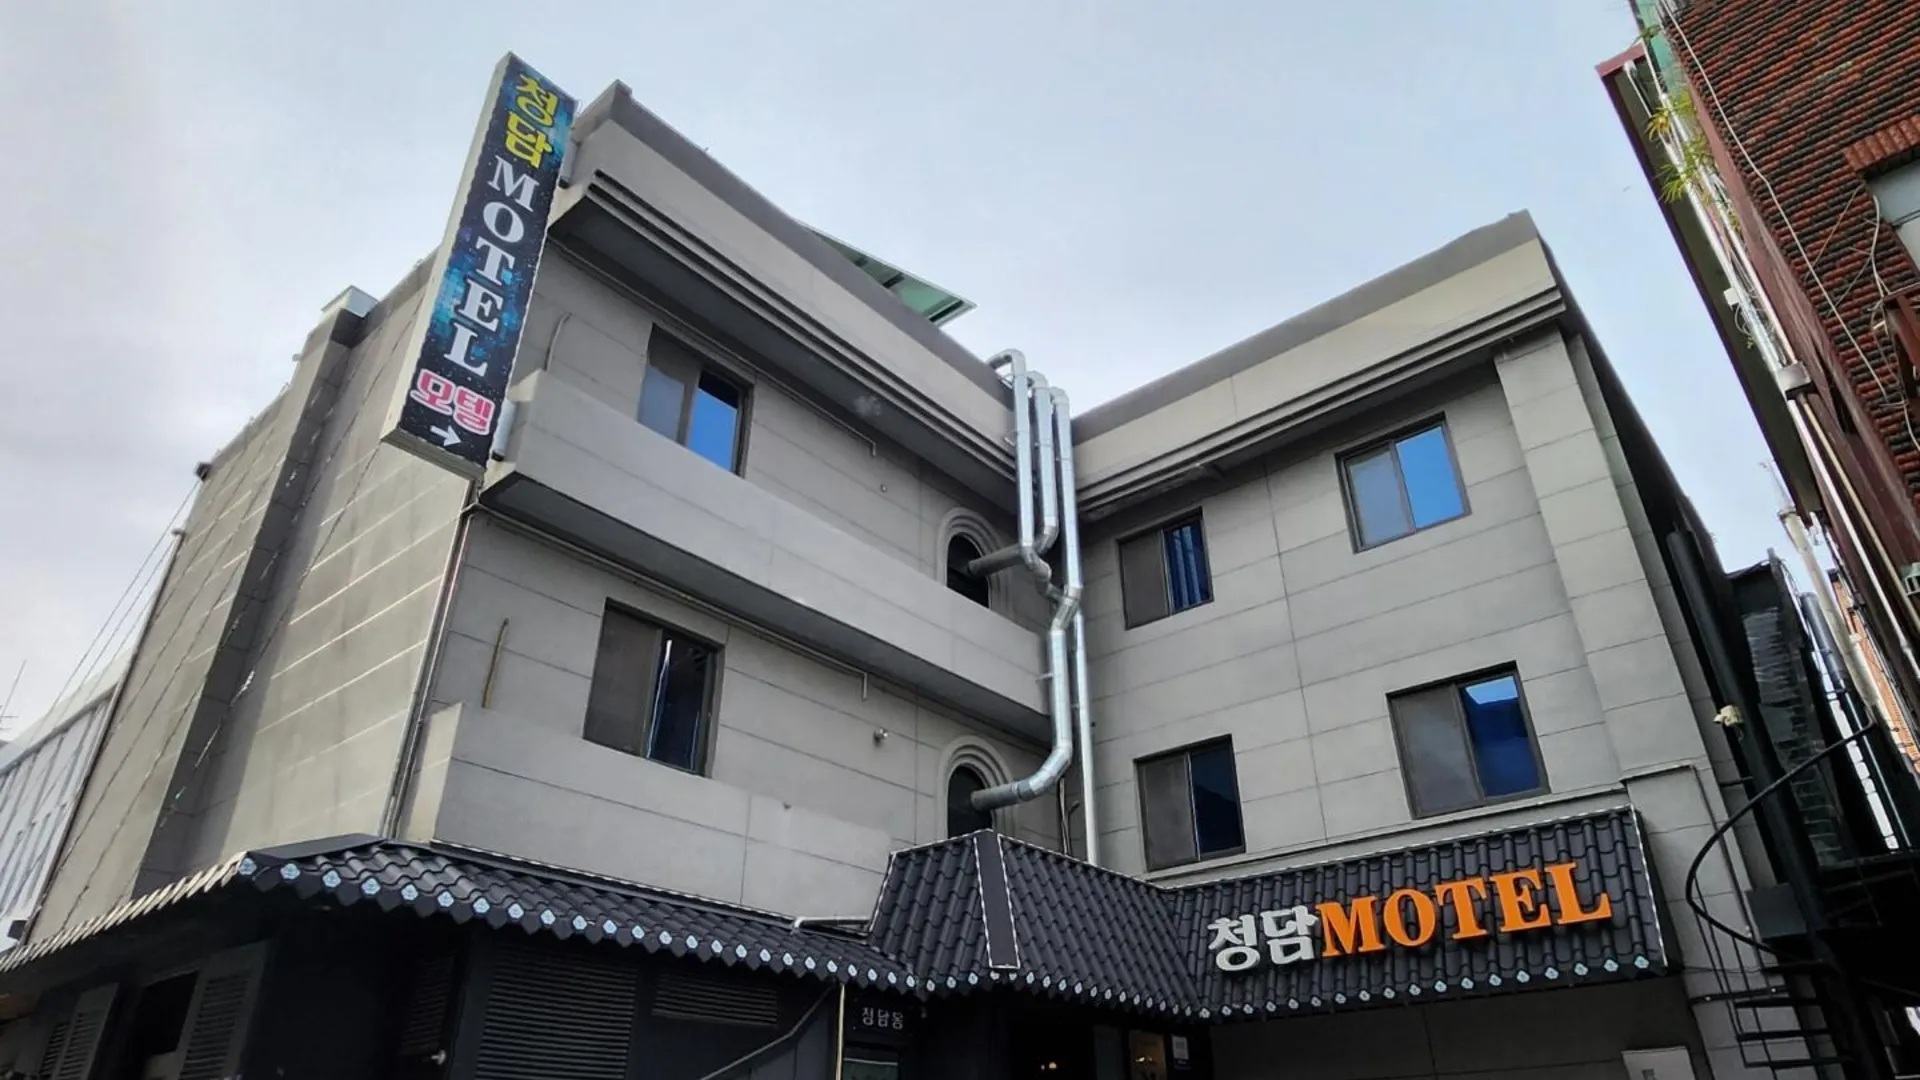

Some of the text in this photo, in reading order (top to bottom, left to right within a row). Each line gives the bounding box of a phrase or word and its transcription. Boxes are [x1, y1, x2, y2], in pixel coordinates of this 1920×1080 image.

[506, 74, 558, 168] 청담
[443, 155, 540, 377] MOTEL
[410, 368, 495, 435] 모텔
[1207, 862, 1613, 971] 청담 MOTEL
